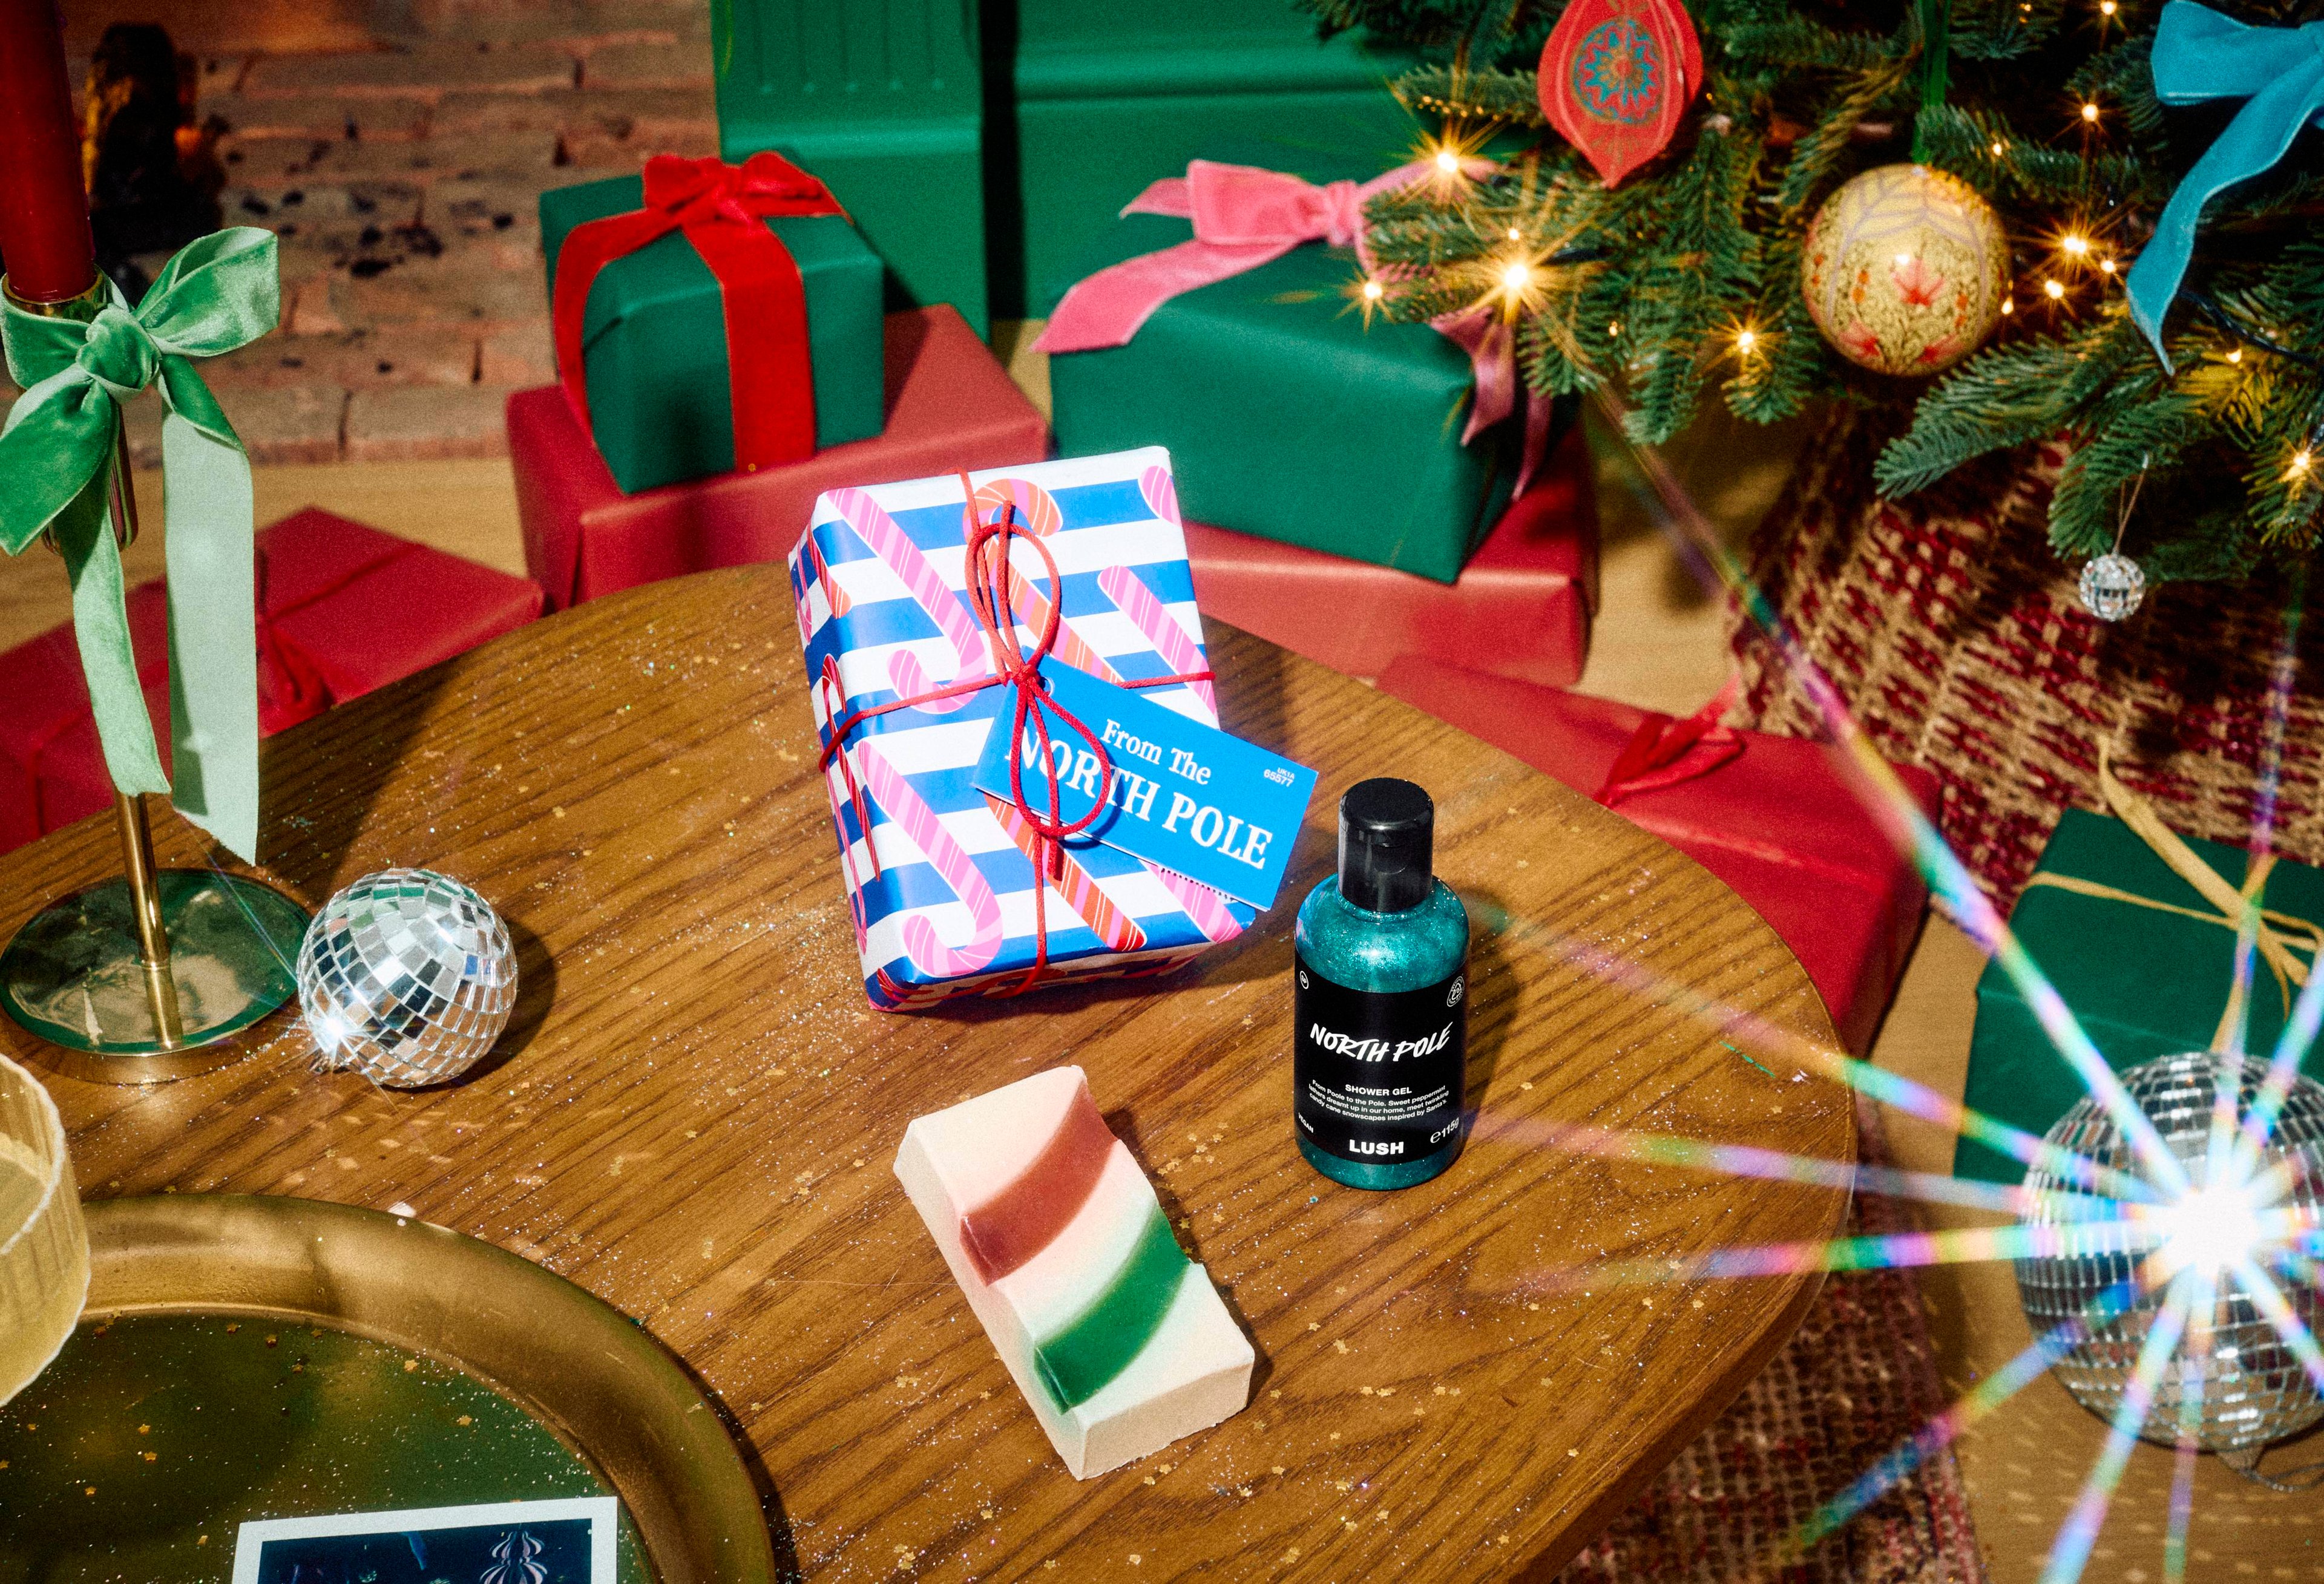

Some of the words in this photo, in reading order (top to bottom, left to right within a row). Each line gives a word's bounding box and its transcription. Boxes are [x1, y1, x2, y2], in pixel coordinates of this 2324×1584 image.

[1101, 719, 1161, 765] From
[1169, 748, 1212, 785] The
[1263, 769, 1293, 787] 65577
[1005, 726, 1161, 822] NORTH
[1162, 792, 1273, 869] POLE
[1310, 1023, 1390, 1062] NORTH
[1393, 1021, 1453, 1062] POLE
[1308, 1083, 1326, 1099] lathers
[1327, 1096, 1349, 1109] dreamt
[1407, 1102, 1424, 1111] meet
[1425, 1090, 1449, 1106] twinkling
[1312, 1079, 1326, 1092] From
[1327, 1088, 1345, 1101] Poole
[1411, 1085, 1446, 1104] peppermint
[1345, 1084, 1390, 1096] SHOWER
[1392, 1087, 1412, 1096] GEL
[1309, 1093, 1325, 1107] candy
[1325, 1104, 1341, 1113] cane
[1342, 1110, 1386, 1122] snowscapes
[1387, 1111, 1416, 1121] inspired
[1298, 1112, 1313, 1133] VEGAN
[1349, 1139, 1404, 1155] LUSH
